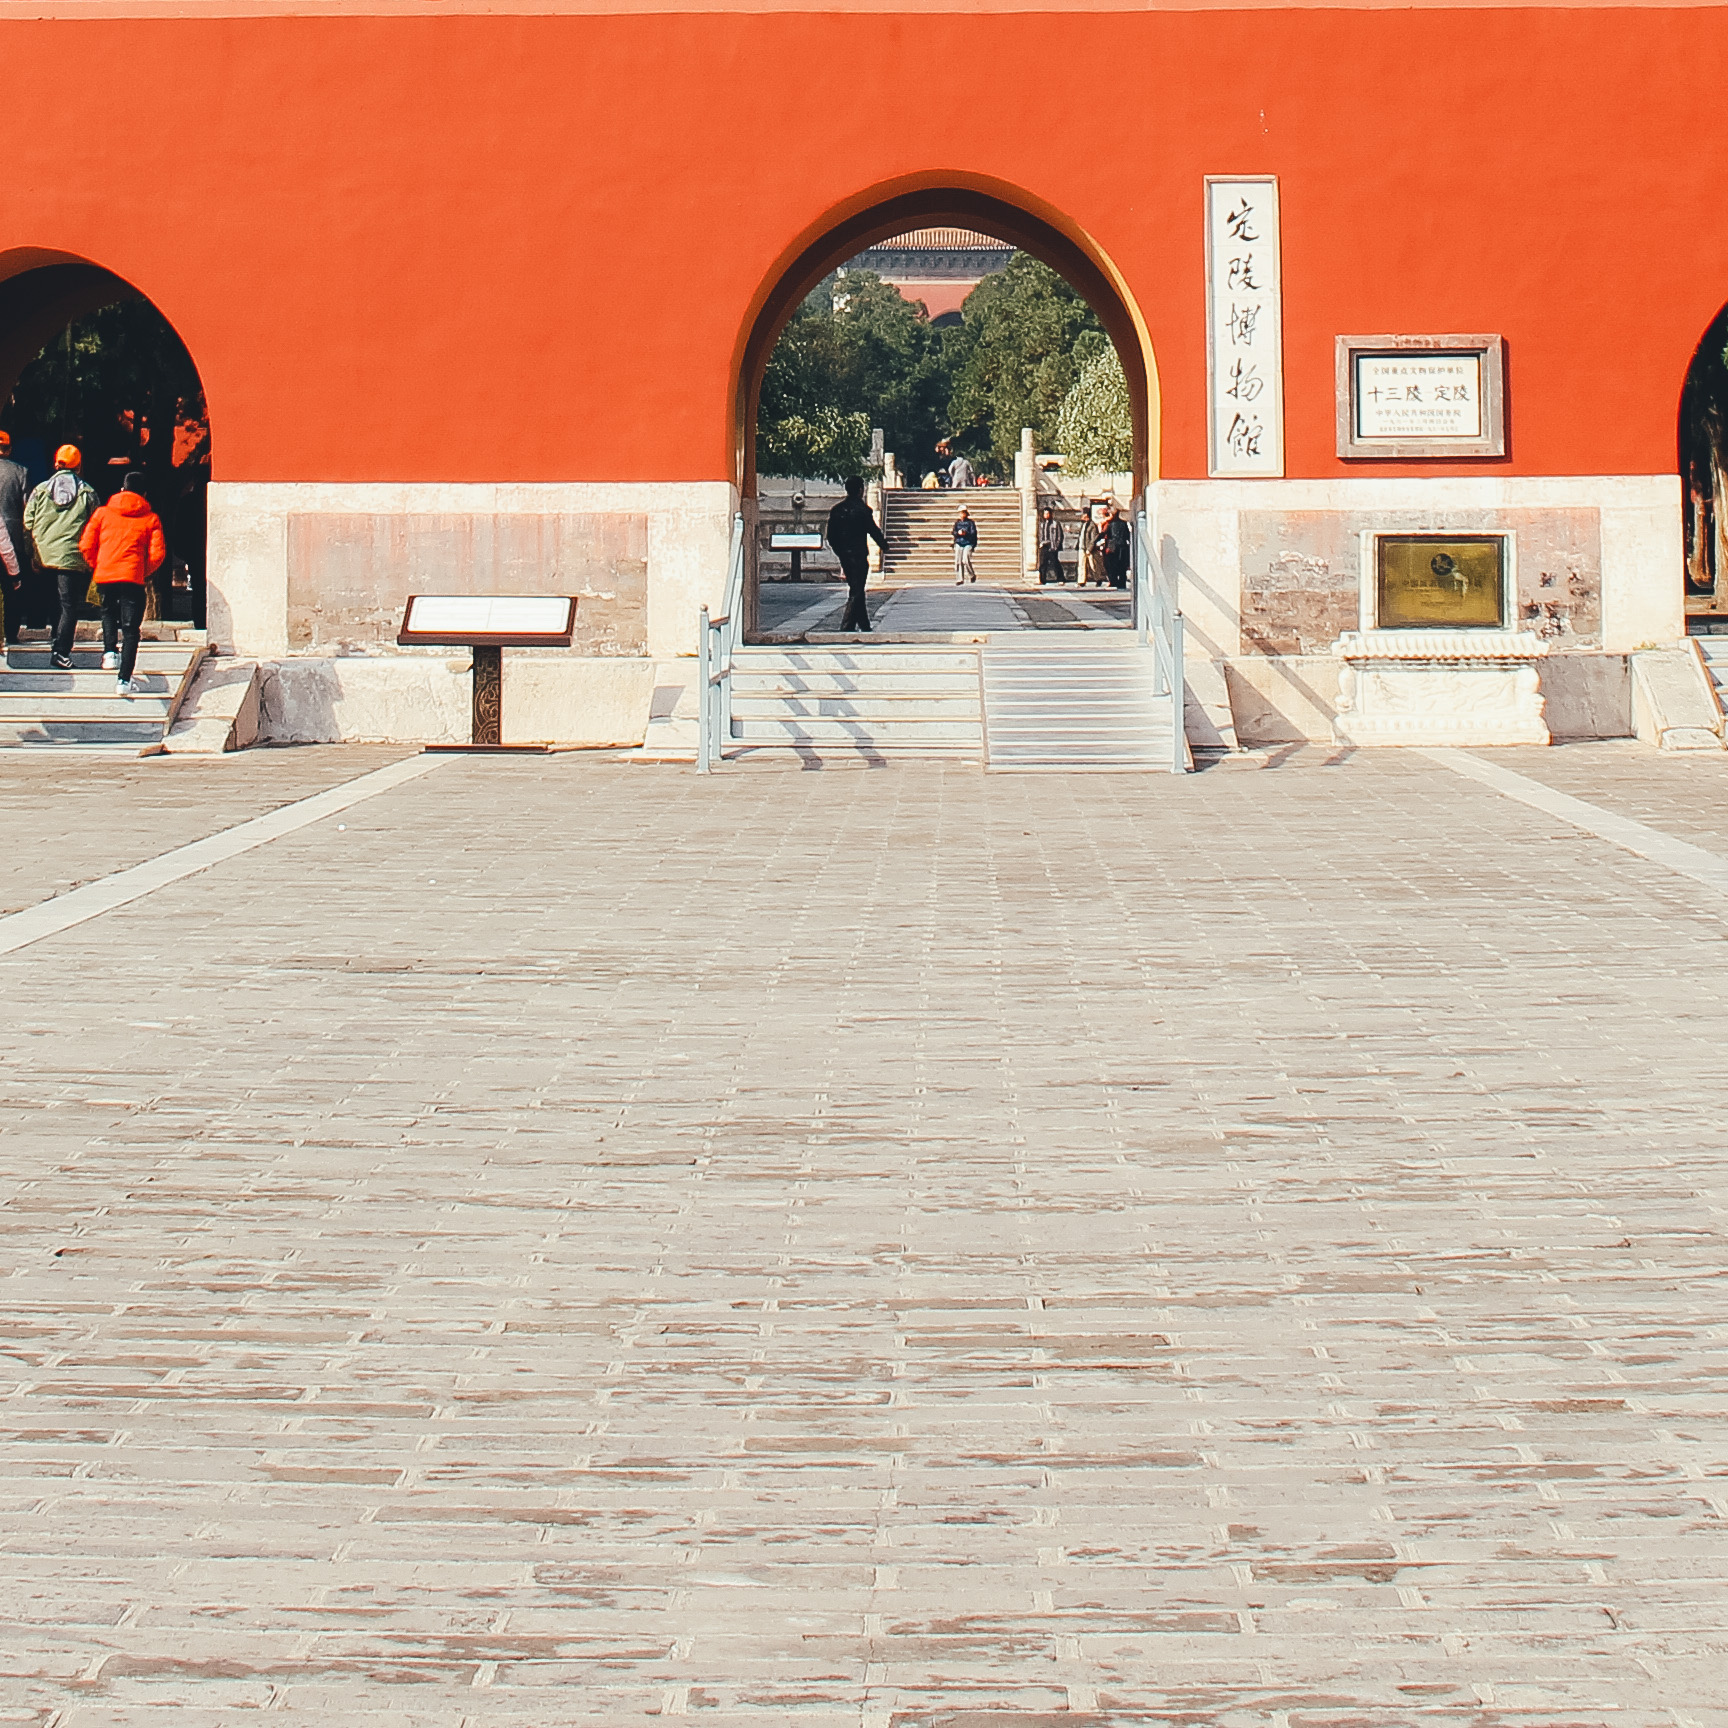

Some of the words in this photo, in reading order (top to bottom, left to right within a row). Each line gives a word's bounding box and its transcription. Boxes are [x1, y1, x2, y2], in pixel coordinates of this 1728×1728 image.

[1225, 197, 1264, 458] 定陵博物館
